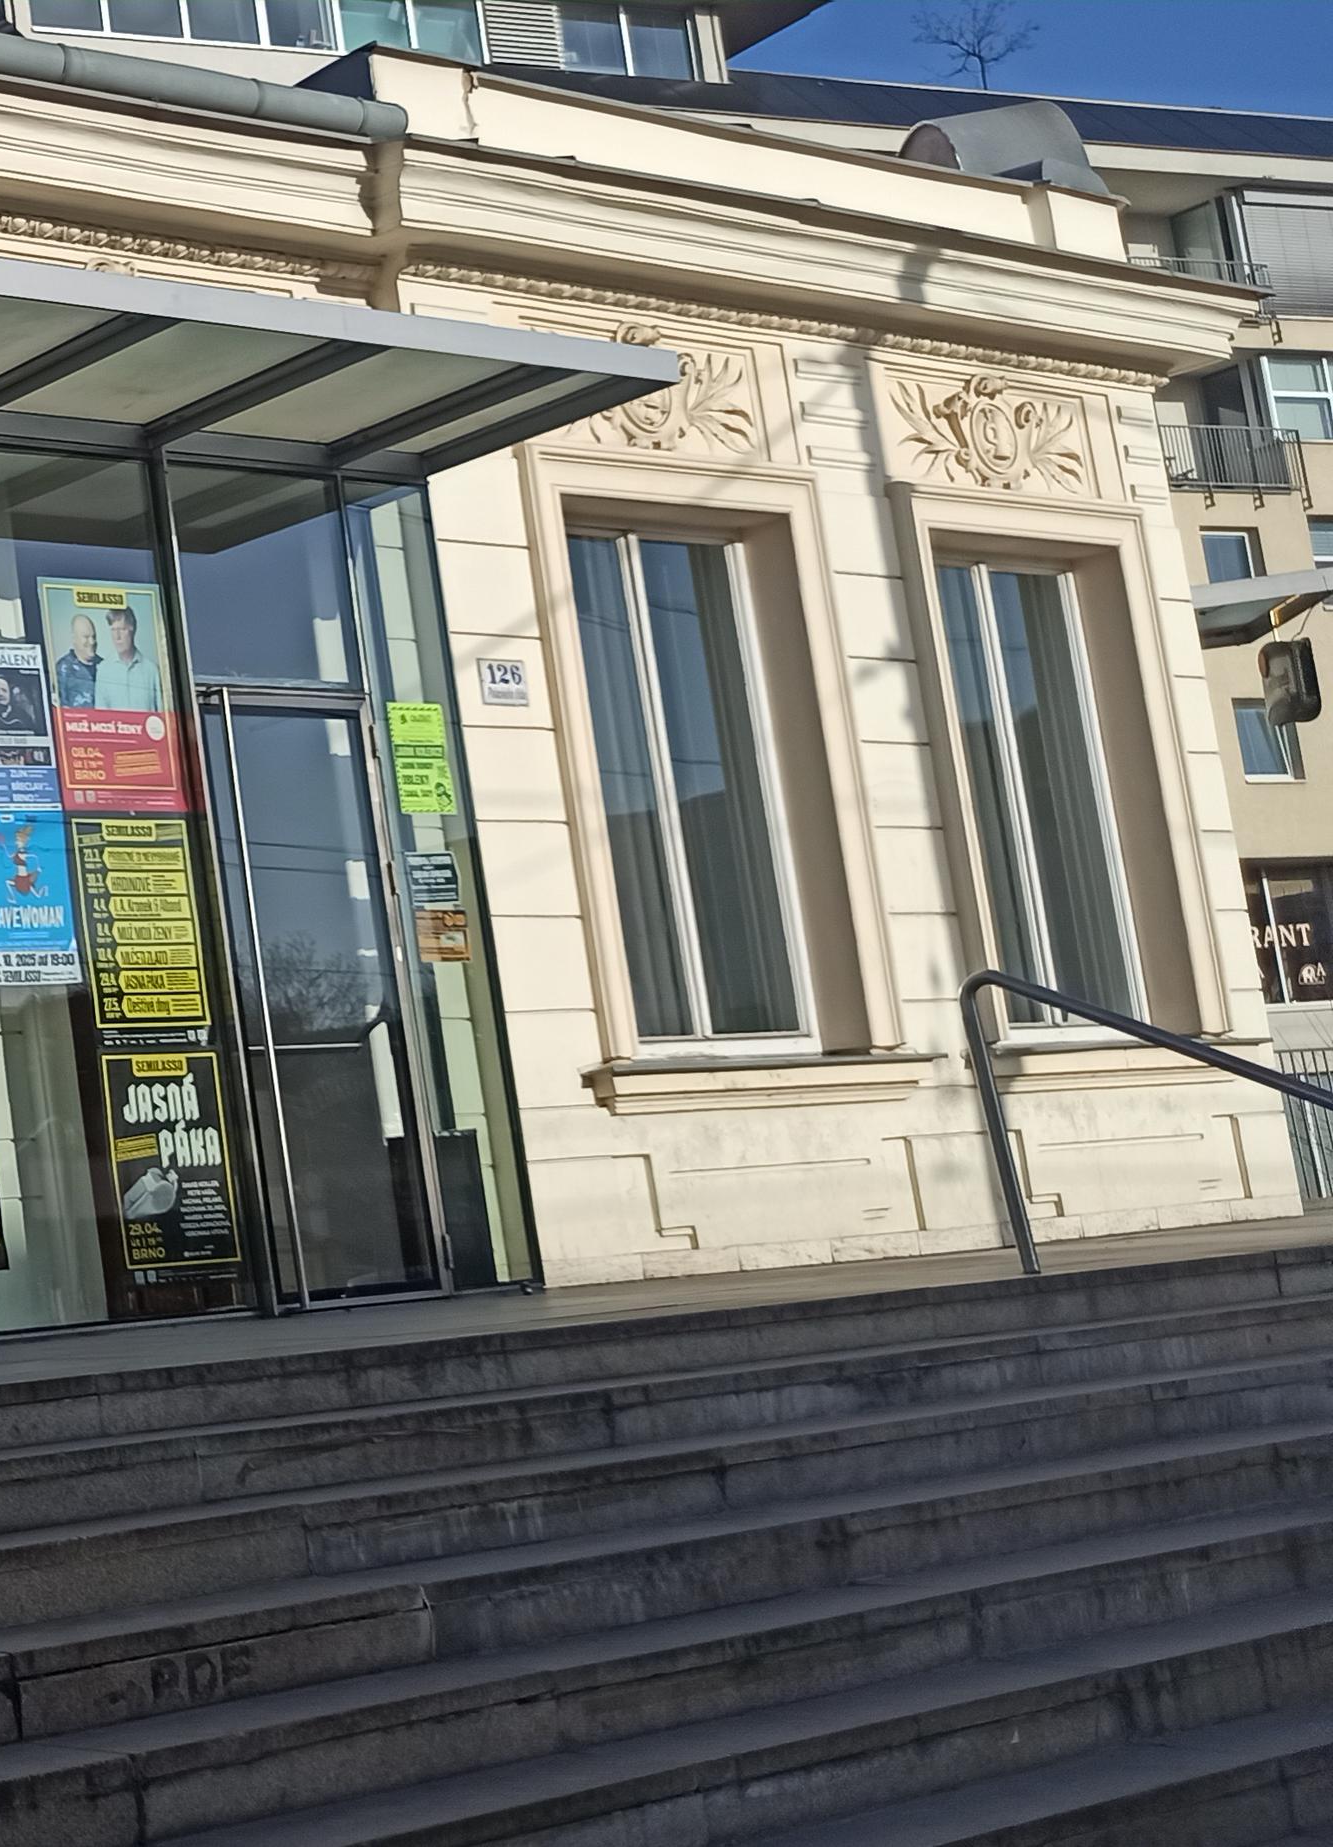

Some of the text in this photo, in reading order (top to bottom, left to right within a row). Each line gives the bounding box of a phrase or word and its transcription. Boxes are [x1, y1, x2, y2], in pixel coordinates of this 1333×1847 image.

[76, 591, 124, 606] SEMILASSO
[486, 663, 522, 686] 126
[74, 769, 106, 781] BRNO
[105, 825, 153, 838] SEMILASSO
[136, 1059, 184, 1073] SEMILASSO
[122, 1072, 201, 1125] JASNÁ
[158, 1119, 222, 1169] PÁKA
[128, 1222, 163, 1236] 29.04.
[132, 1246, 166, 1260] BRNO
